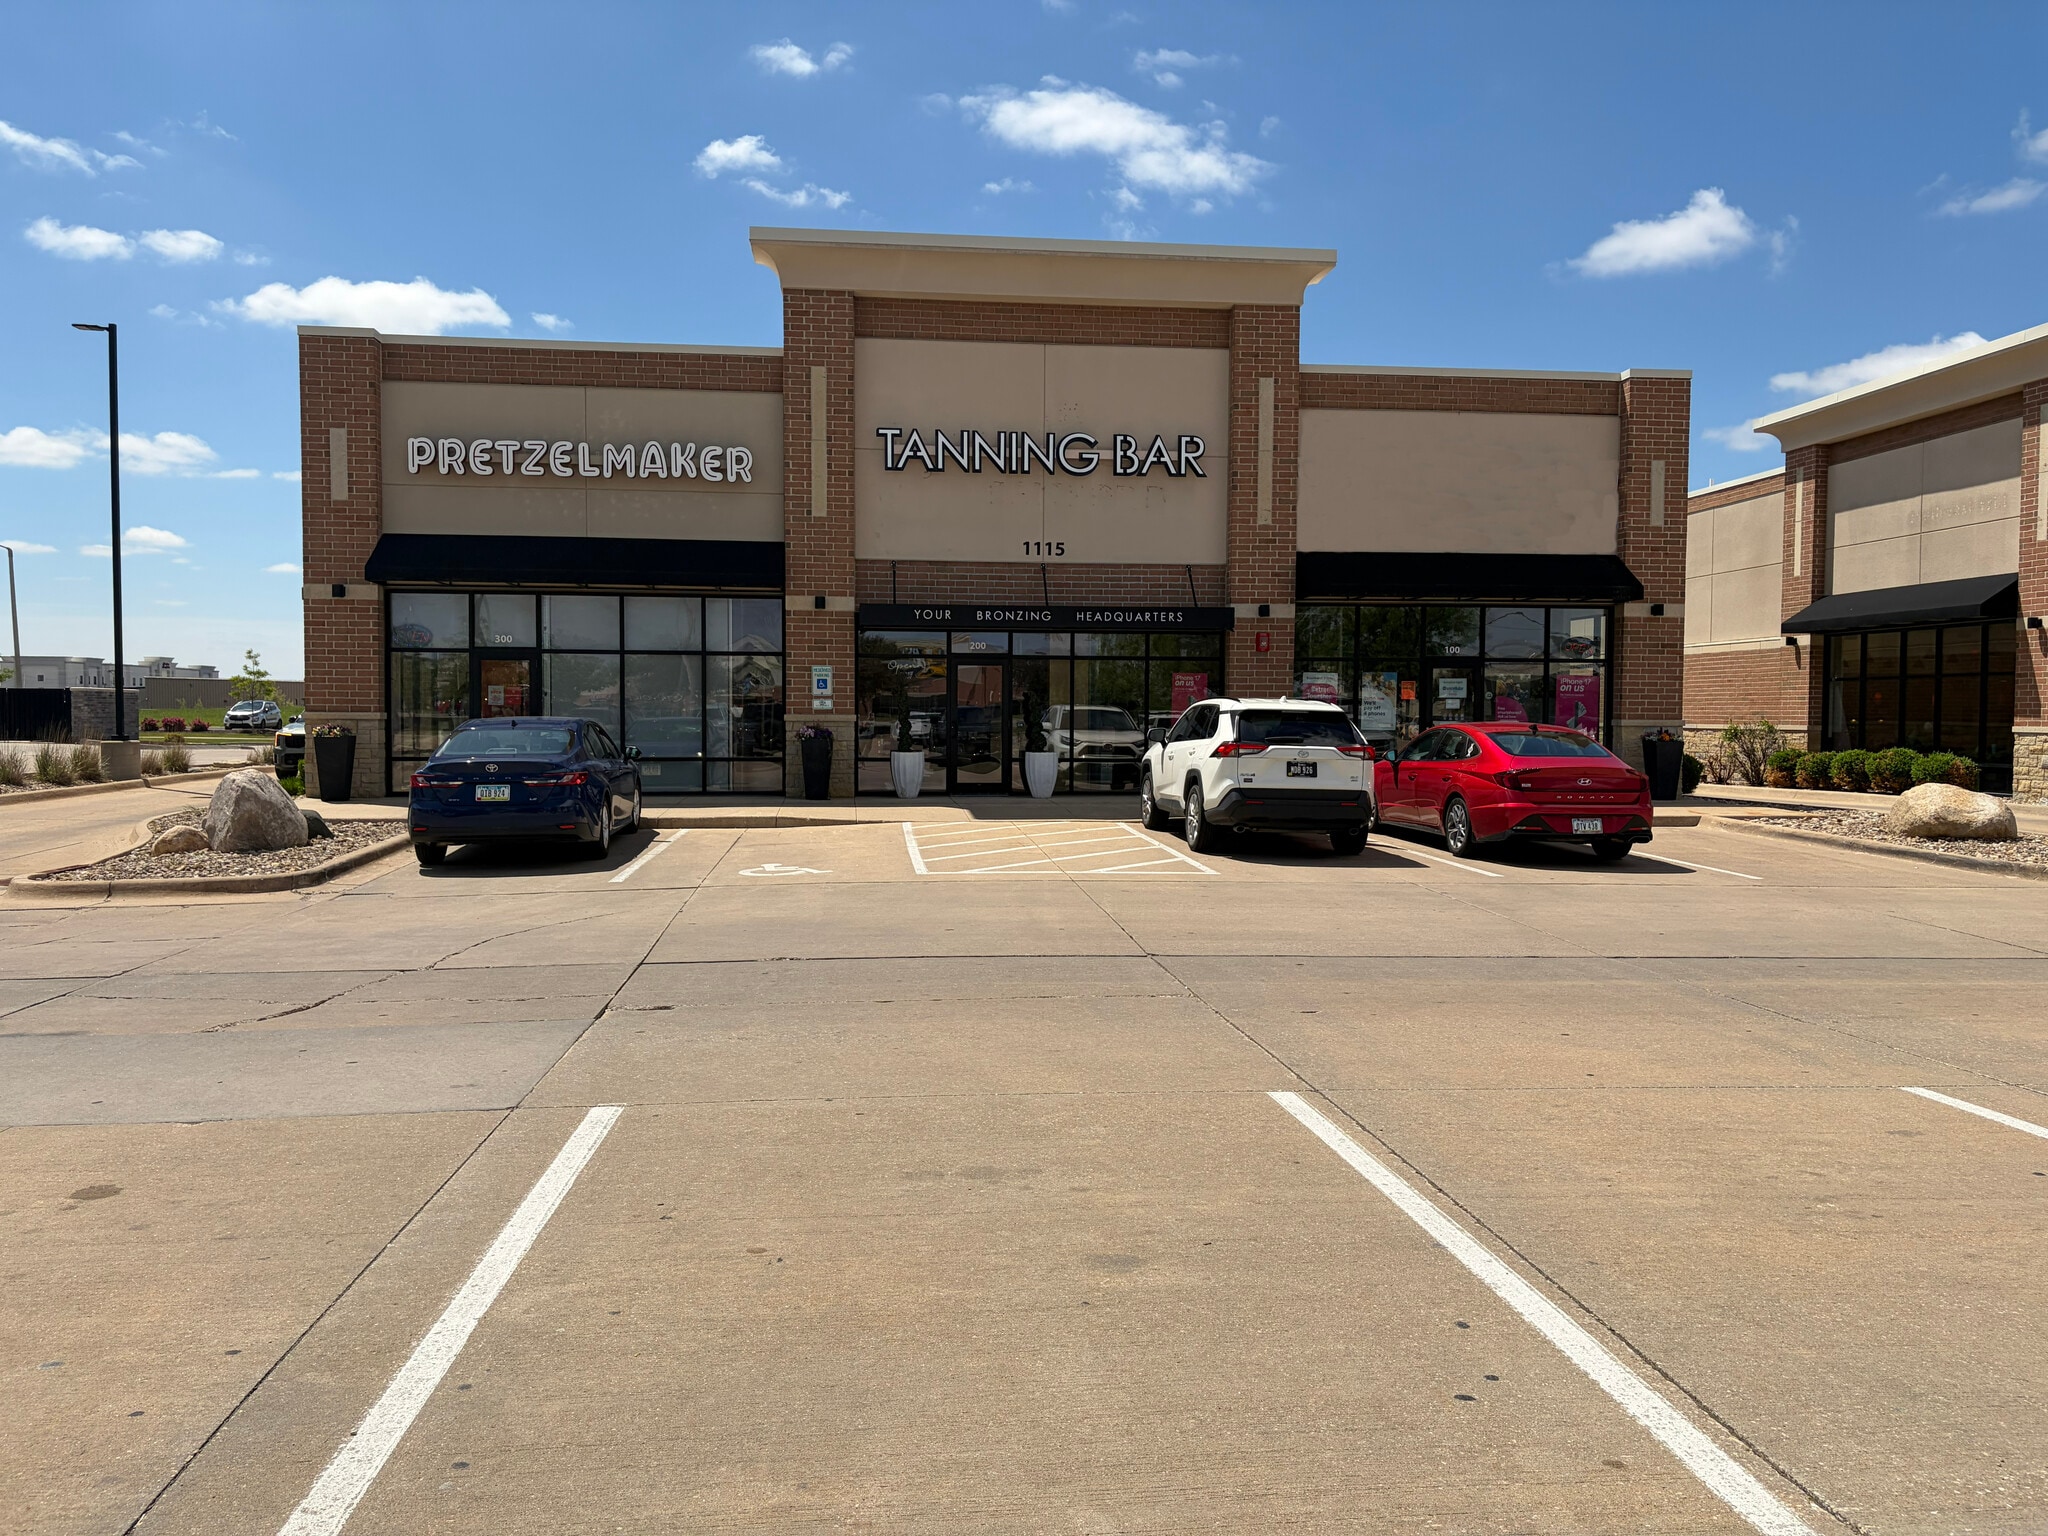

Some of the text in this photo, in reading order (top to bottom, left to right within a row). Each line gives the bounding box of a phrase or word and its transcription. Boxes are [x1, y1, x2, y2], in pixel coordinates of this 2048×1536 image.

[876, 427, 1207, 478] TANNING BAR
[407, 437, 754, 483] PRETZELMAKER
[1022, 541, 1066, 557] 1115
[913, 609, 1184, 623] YOUR BRONZING HEADQUARTERS
[494, 635, 513, 643] 300
[969, 642, 987, 650] 200
[1444, 646, 1460, 654] 100
[493, 789, 506, 798] 924
